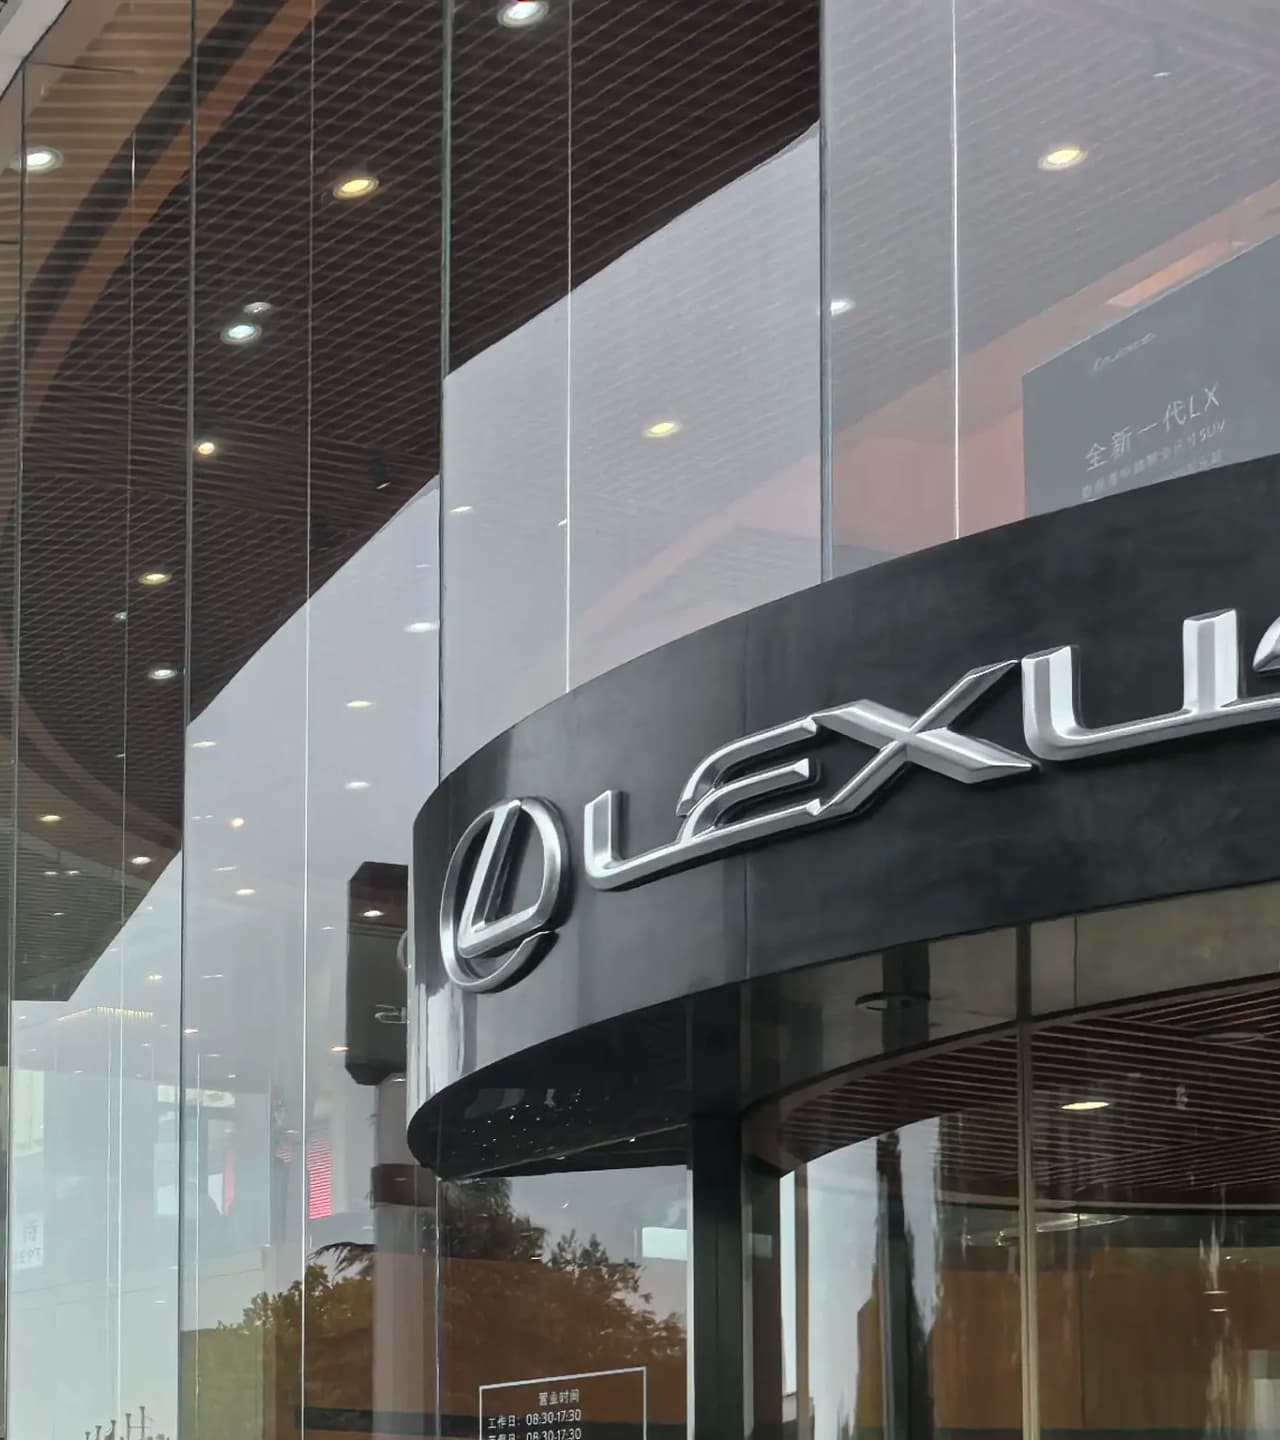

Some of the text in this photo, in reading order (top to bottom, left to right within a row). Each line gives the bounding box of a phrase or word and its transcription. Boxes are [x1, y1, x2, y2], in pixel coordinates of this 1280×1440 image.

[584, 608, 1280, 892] LEXU
[538, 1388, 580, 1407] 营业时间
